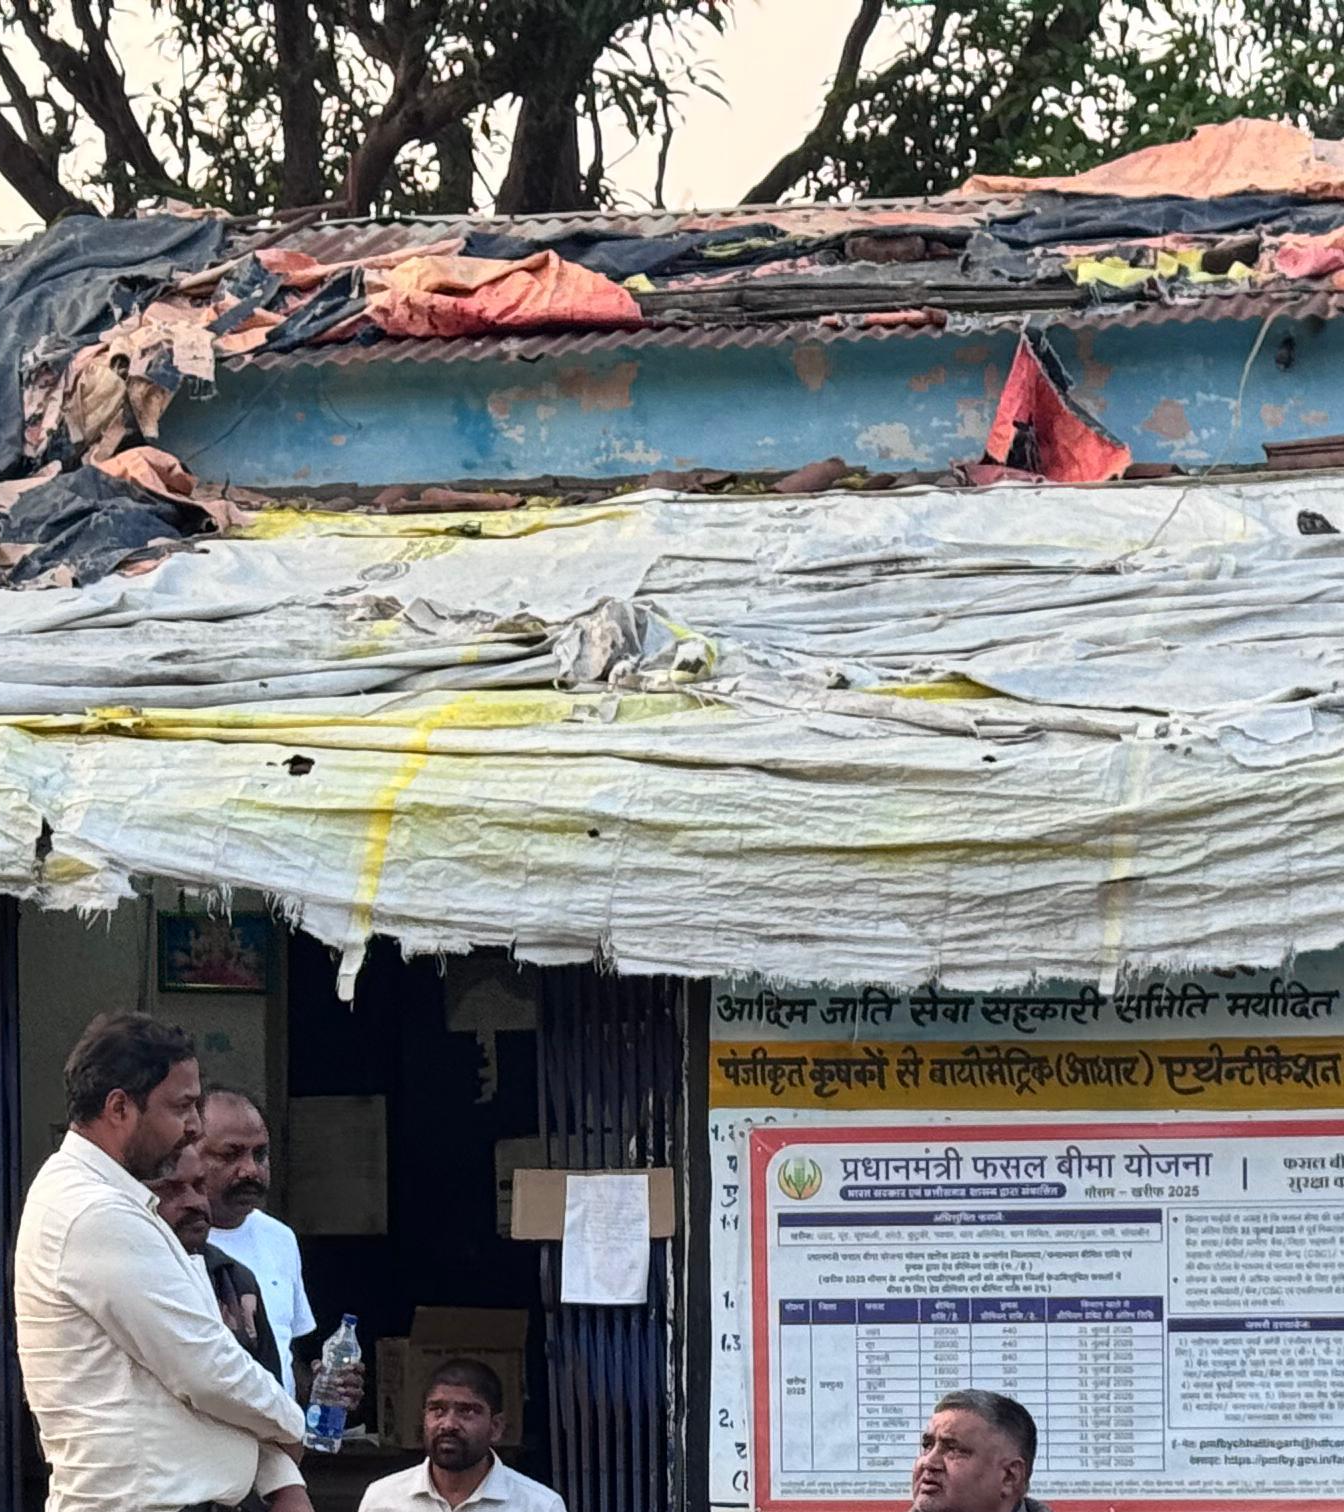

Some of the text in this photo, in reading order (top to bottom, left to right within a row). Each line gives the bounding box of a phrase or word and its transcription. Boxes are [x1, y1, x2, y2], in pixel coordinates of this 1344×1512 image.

[717, 988, 816, 1029] आदिम
[818, 988, 900, 1025] जाति
[910, 983, 974, 1026] सेवा
[980, 983, 1114, 1033] सहकारी
[1115, 983, 1219, 1023] समिति
[1226, 976, 1338, 1020] मर्यादित
[717, 1048, 806, 1094] पंजीकृत
[808, 1046, 889, 1098] कृषकों
[896, 1047, 924, 1089] से
[842, 1144, 1213, 1182] प्रधानमंत्री फसल बीमा योजना
[1283, 1155, 1326, 1170] फसल
[1168, 1186, 1199, 1198] 2025
[1288, 1174, 1329, 1193] सुरक्षा
